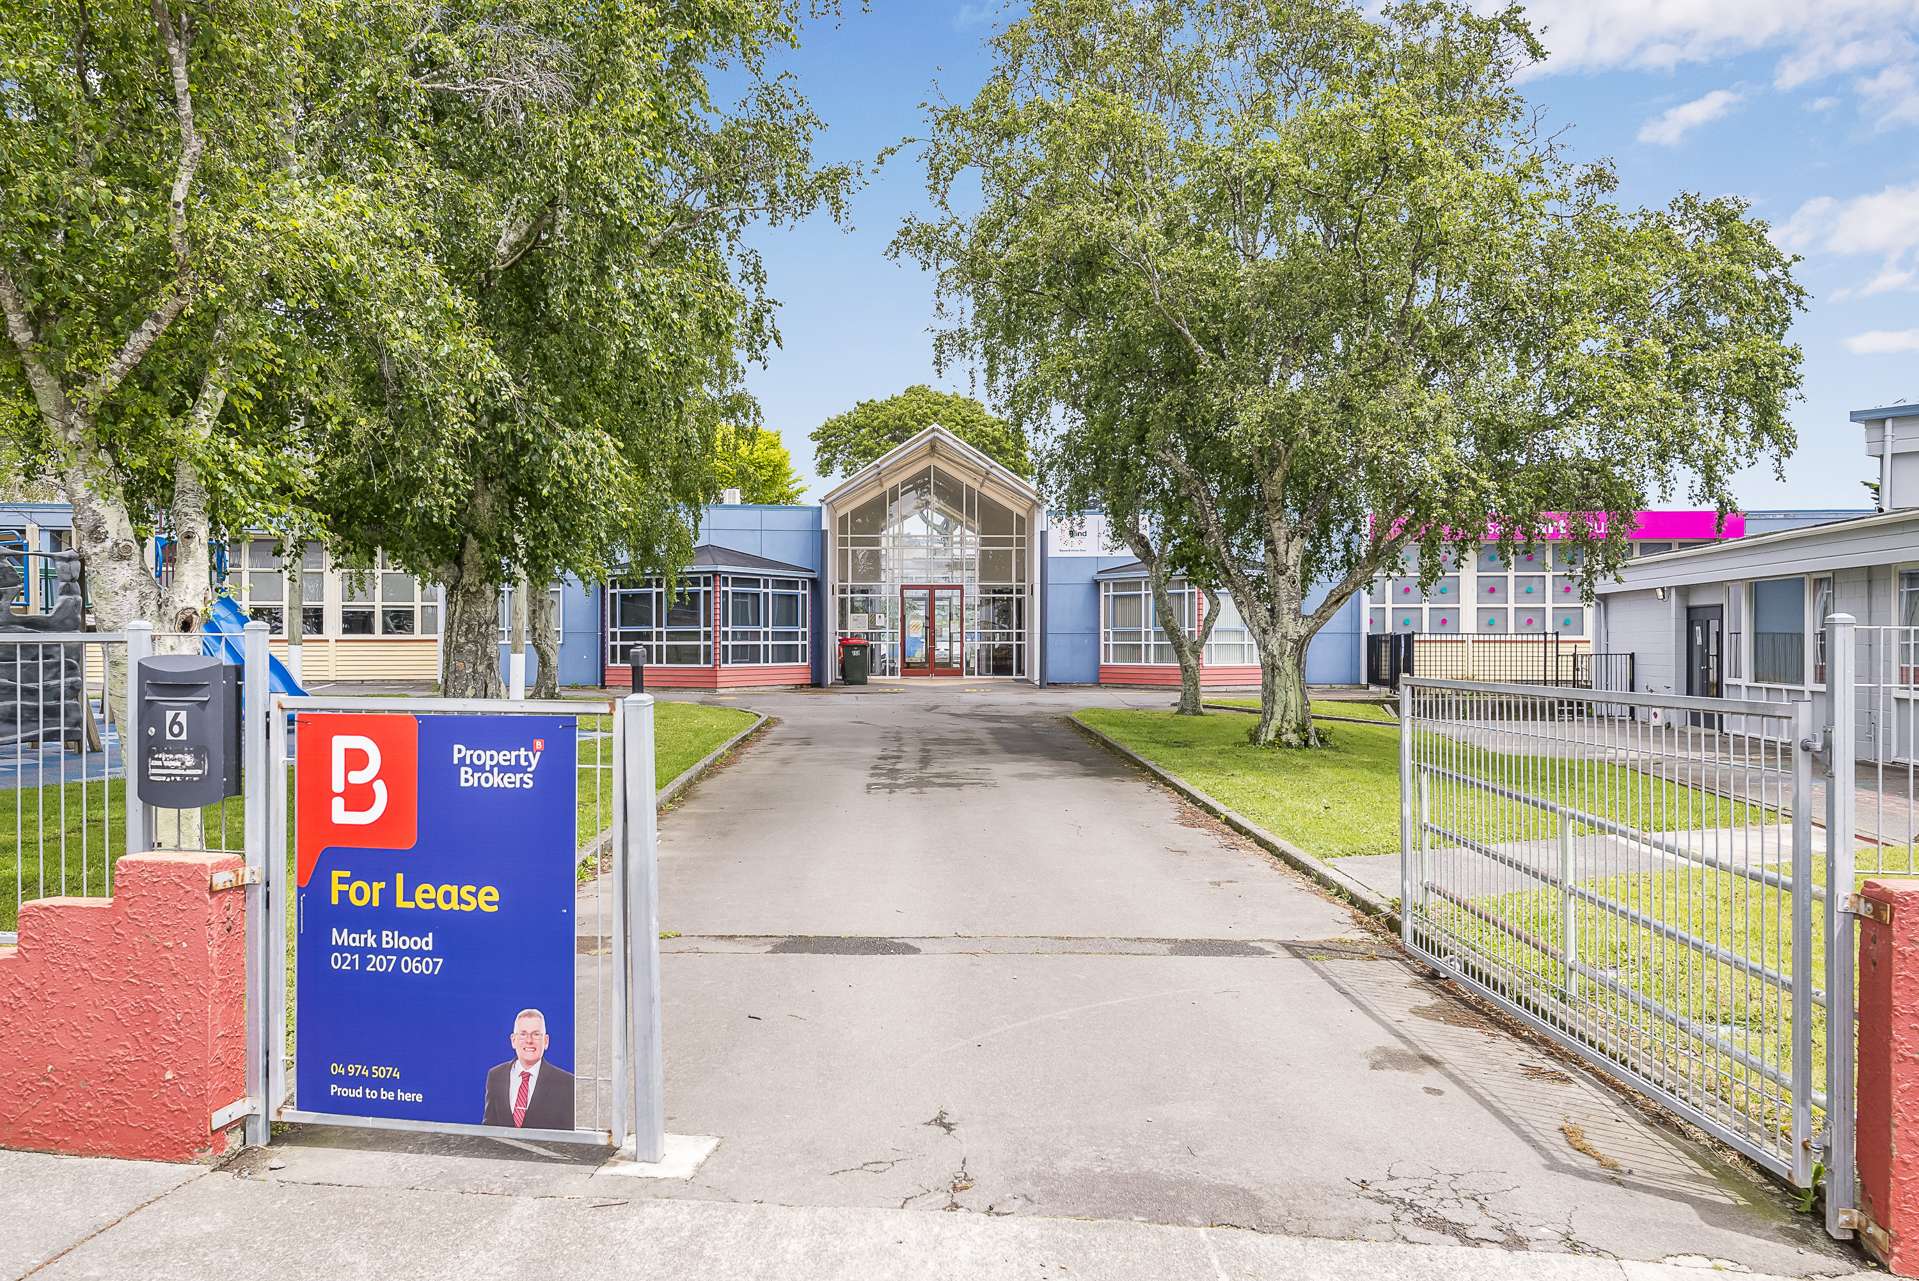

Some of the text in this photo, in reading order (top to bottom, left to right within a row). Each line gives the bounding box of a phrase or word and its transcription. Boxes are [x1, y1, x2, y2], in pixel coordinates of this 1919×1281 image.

[168, 711, 184, 738] 6
[453, 743, 542, 772] Property
[331, 735, 388, 825] B
[460, 766, 534, 789] Brokers
[330, 870, 500, 912] For Lease
[331, 927, 433, 951] Mark Blood
[330, 952, 444, 975] 021 207 0607
[330, 1062, 400, 1080] 04 974 5074
[330, 1084, 423, 1103] Proud to be here
